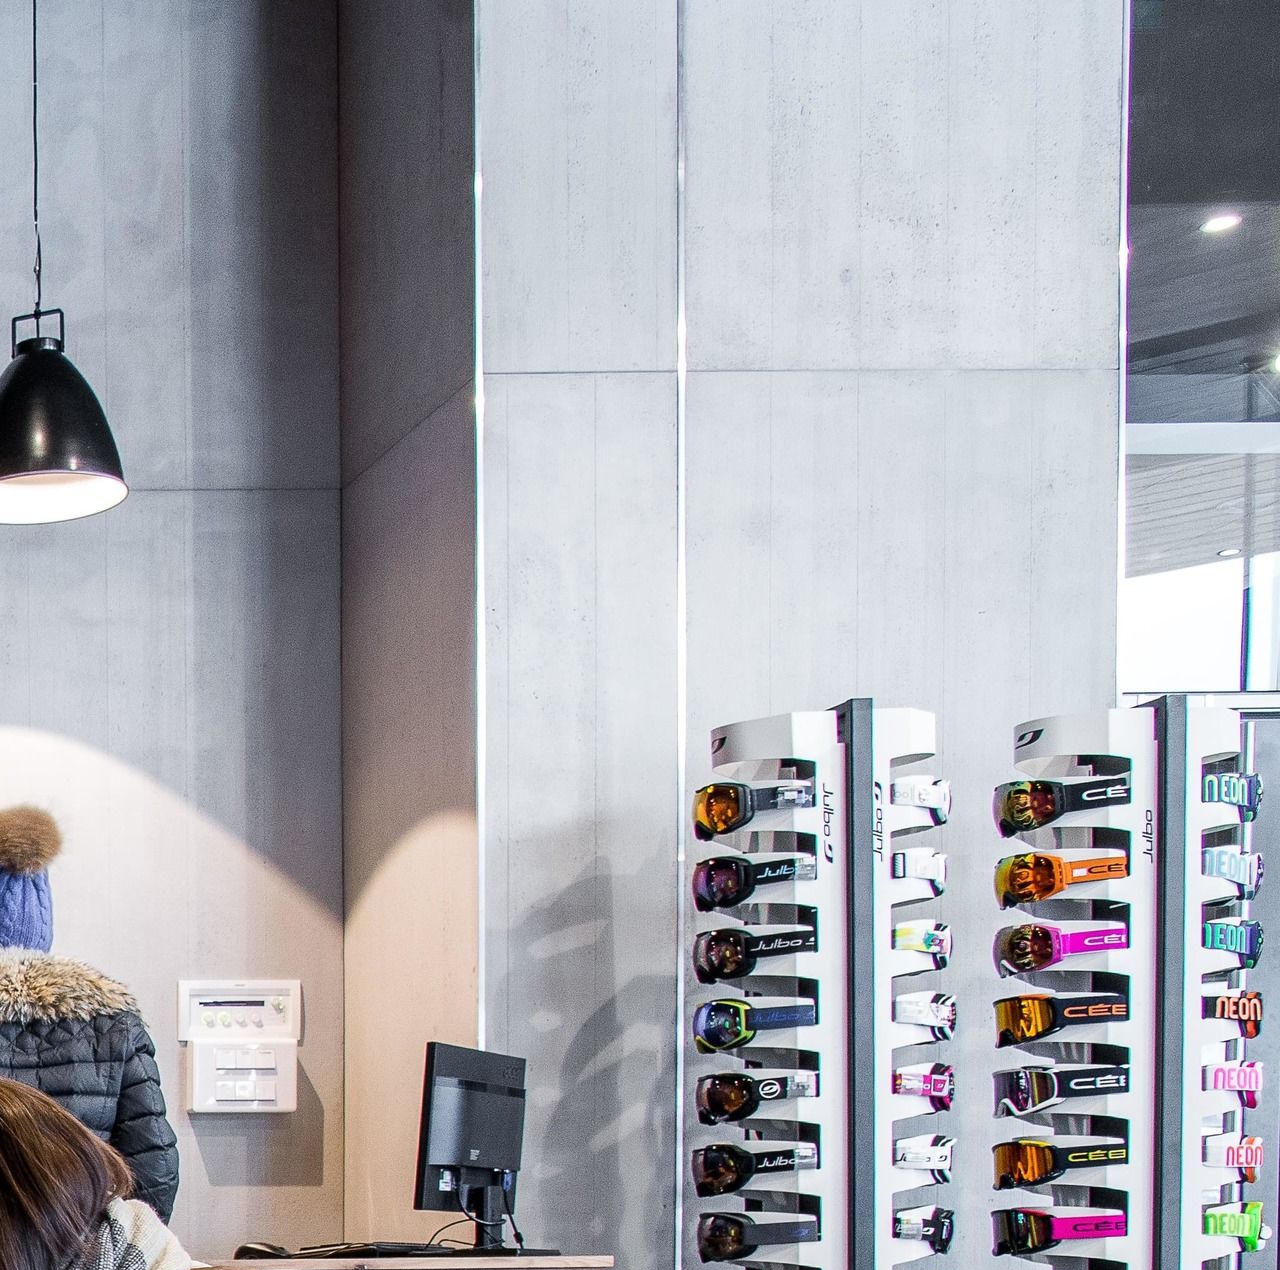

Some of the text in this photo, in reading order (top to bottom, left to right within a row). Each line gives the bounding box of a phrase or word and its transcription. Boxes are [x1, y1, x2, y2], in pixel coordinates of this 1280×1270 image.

[1082, 784, 1129, 800] CÉ
[823, 782, 834, 837] Julbo
[872, 808, 883, 862] Julbo
[1142, 809, 1153, 864] Julbo
[756, 864, 797, 879] Julb
[1087, 863, 1125, 874] CÉ
[750, 938, 802, 952] Julbo
[1083, 935, 1128, 946] CÉ
[1068, 1149, 1127, 1163] CÉB
